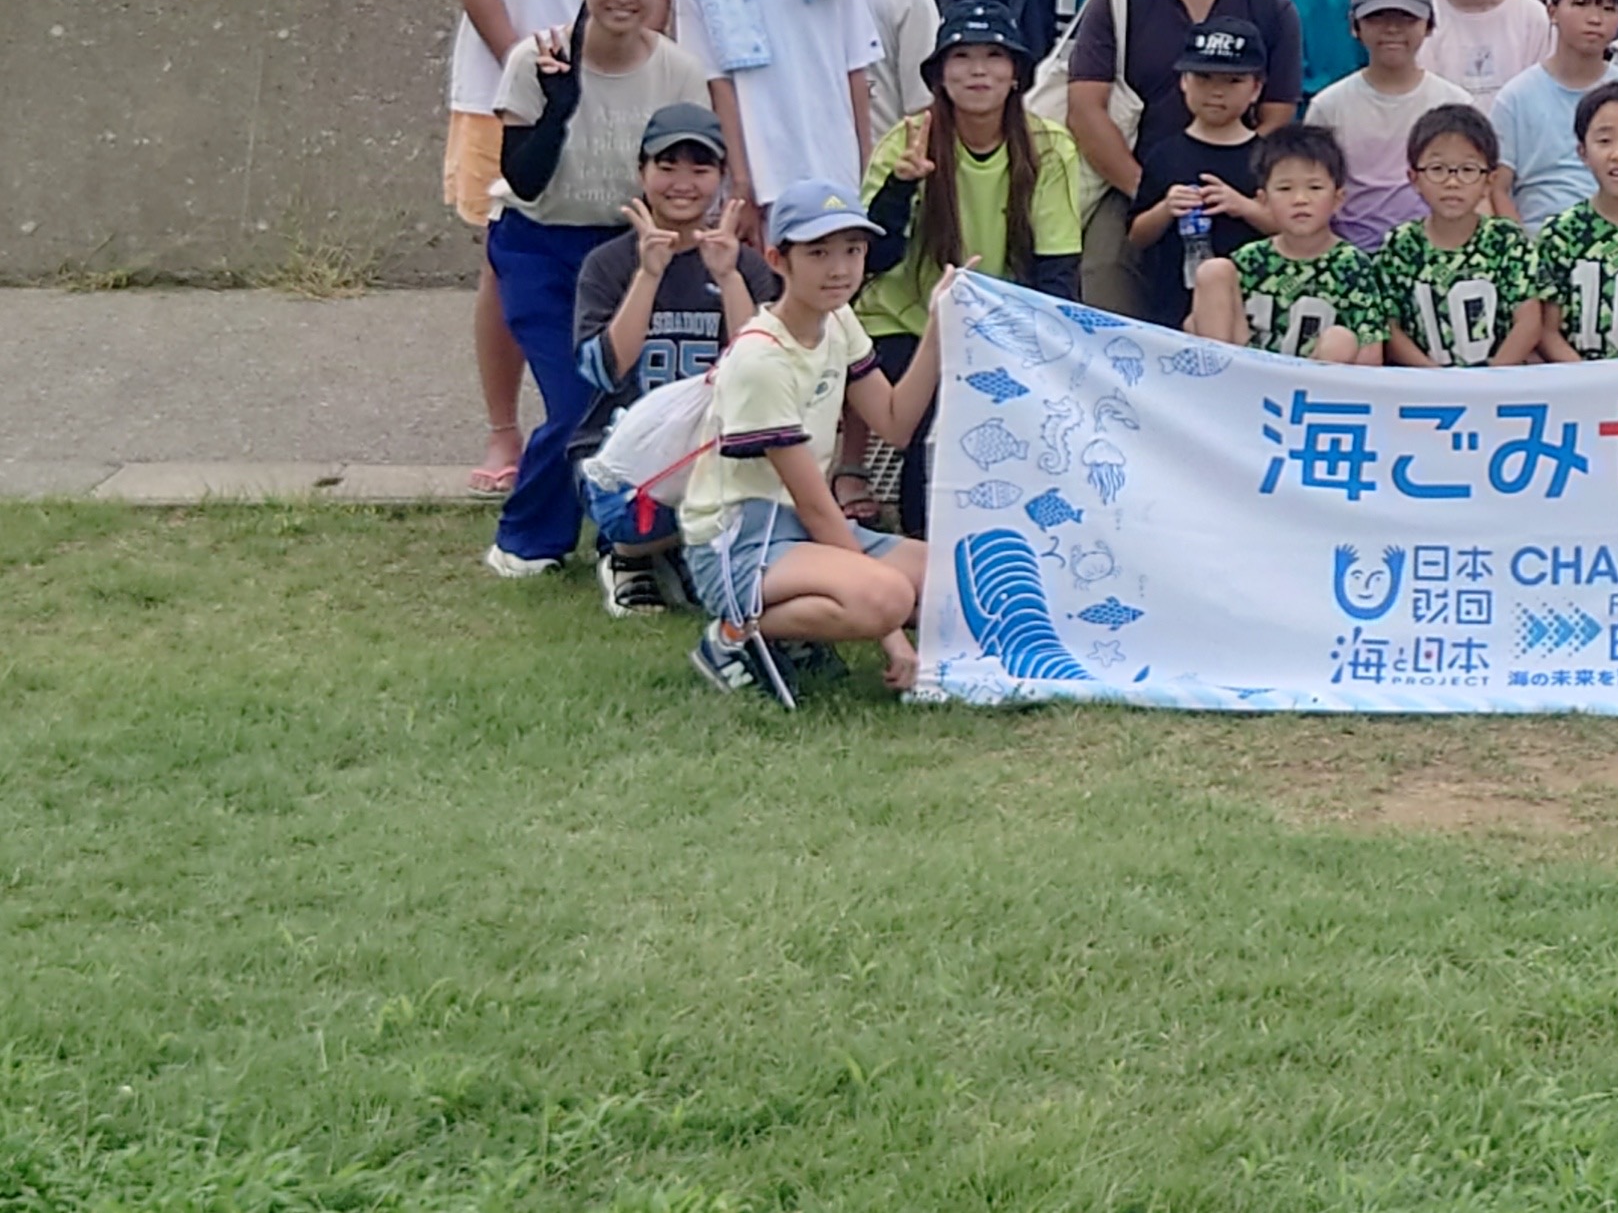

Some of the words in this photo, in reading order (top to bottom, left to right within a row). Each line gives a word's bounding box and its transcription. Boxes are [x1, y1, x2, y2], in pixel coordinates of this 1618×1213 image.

[647, 311, 721, 337] SHADOW
[1414, 279, 1498, 366] 10
[1412, 545, 1493, 582] 日本
[1330, 626, 1490, 684] 海と日本
[1391, 676, 1490, 687] PROJECT
